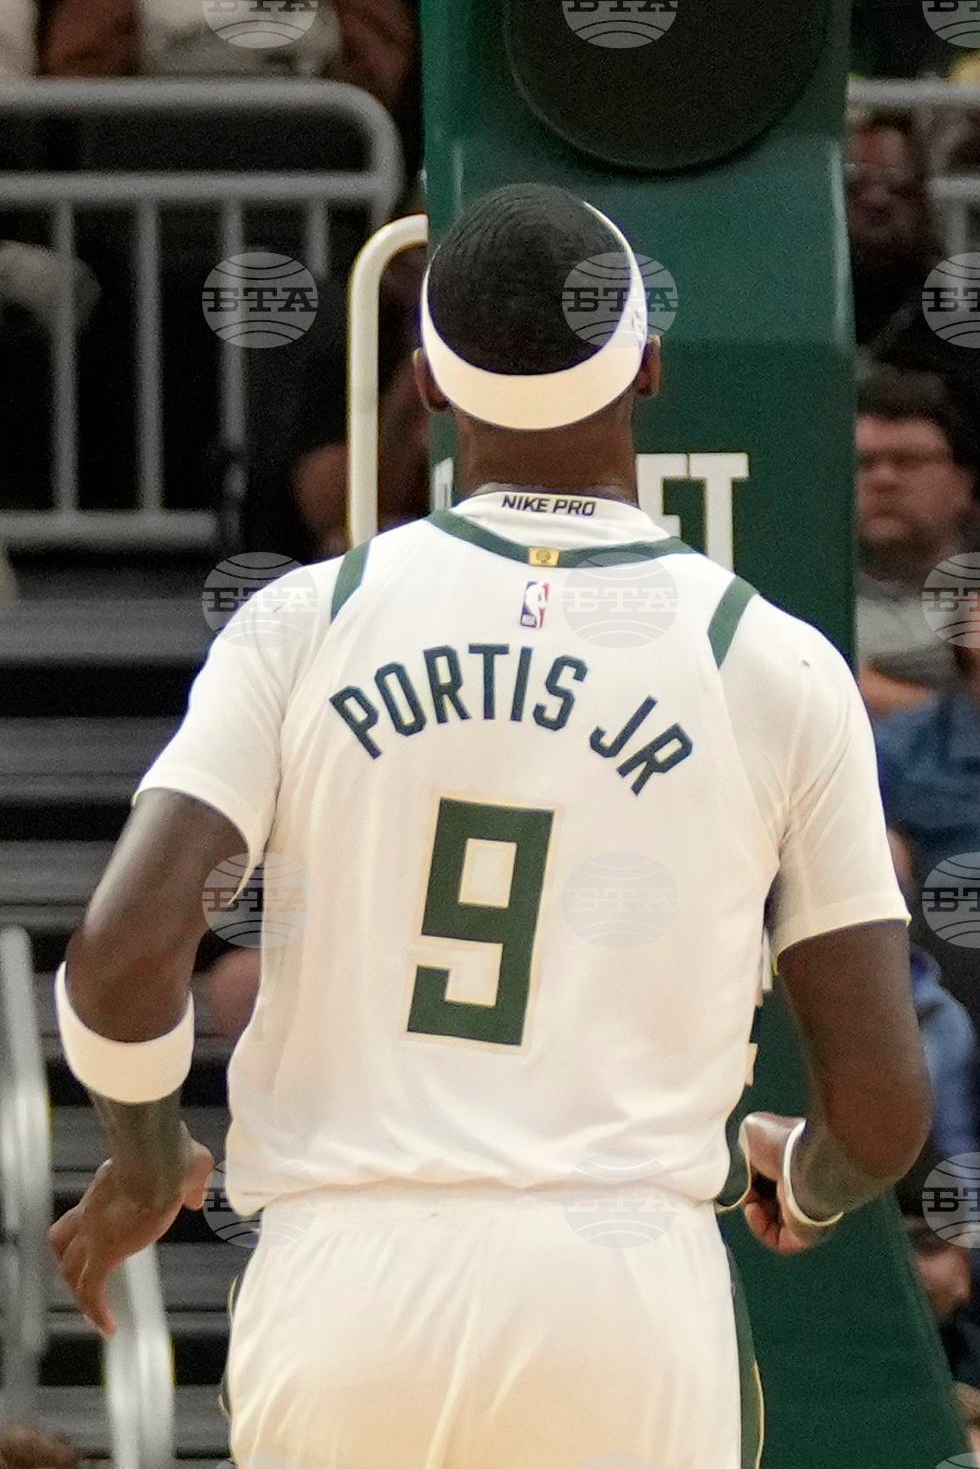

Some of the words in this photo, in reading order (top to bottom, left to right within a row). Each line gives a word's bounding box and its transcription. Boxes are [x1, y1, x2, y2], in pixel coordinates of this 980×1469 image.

[501, 494, 550, 513] NIKE
[552, 498, 597, 517] PRO
[329, 643, 589, 760] PORTIS
[589, 695, 694, 797] JR
[405, 795, 556, 1048] 9
